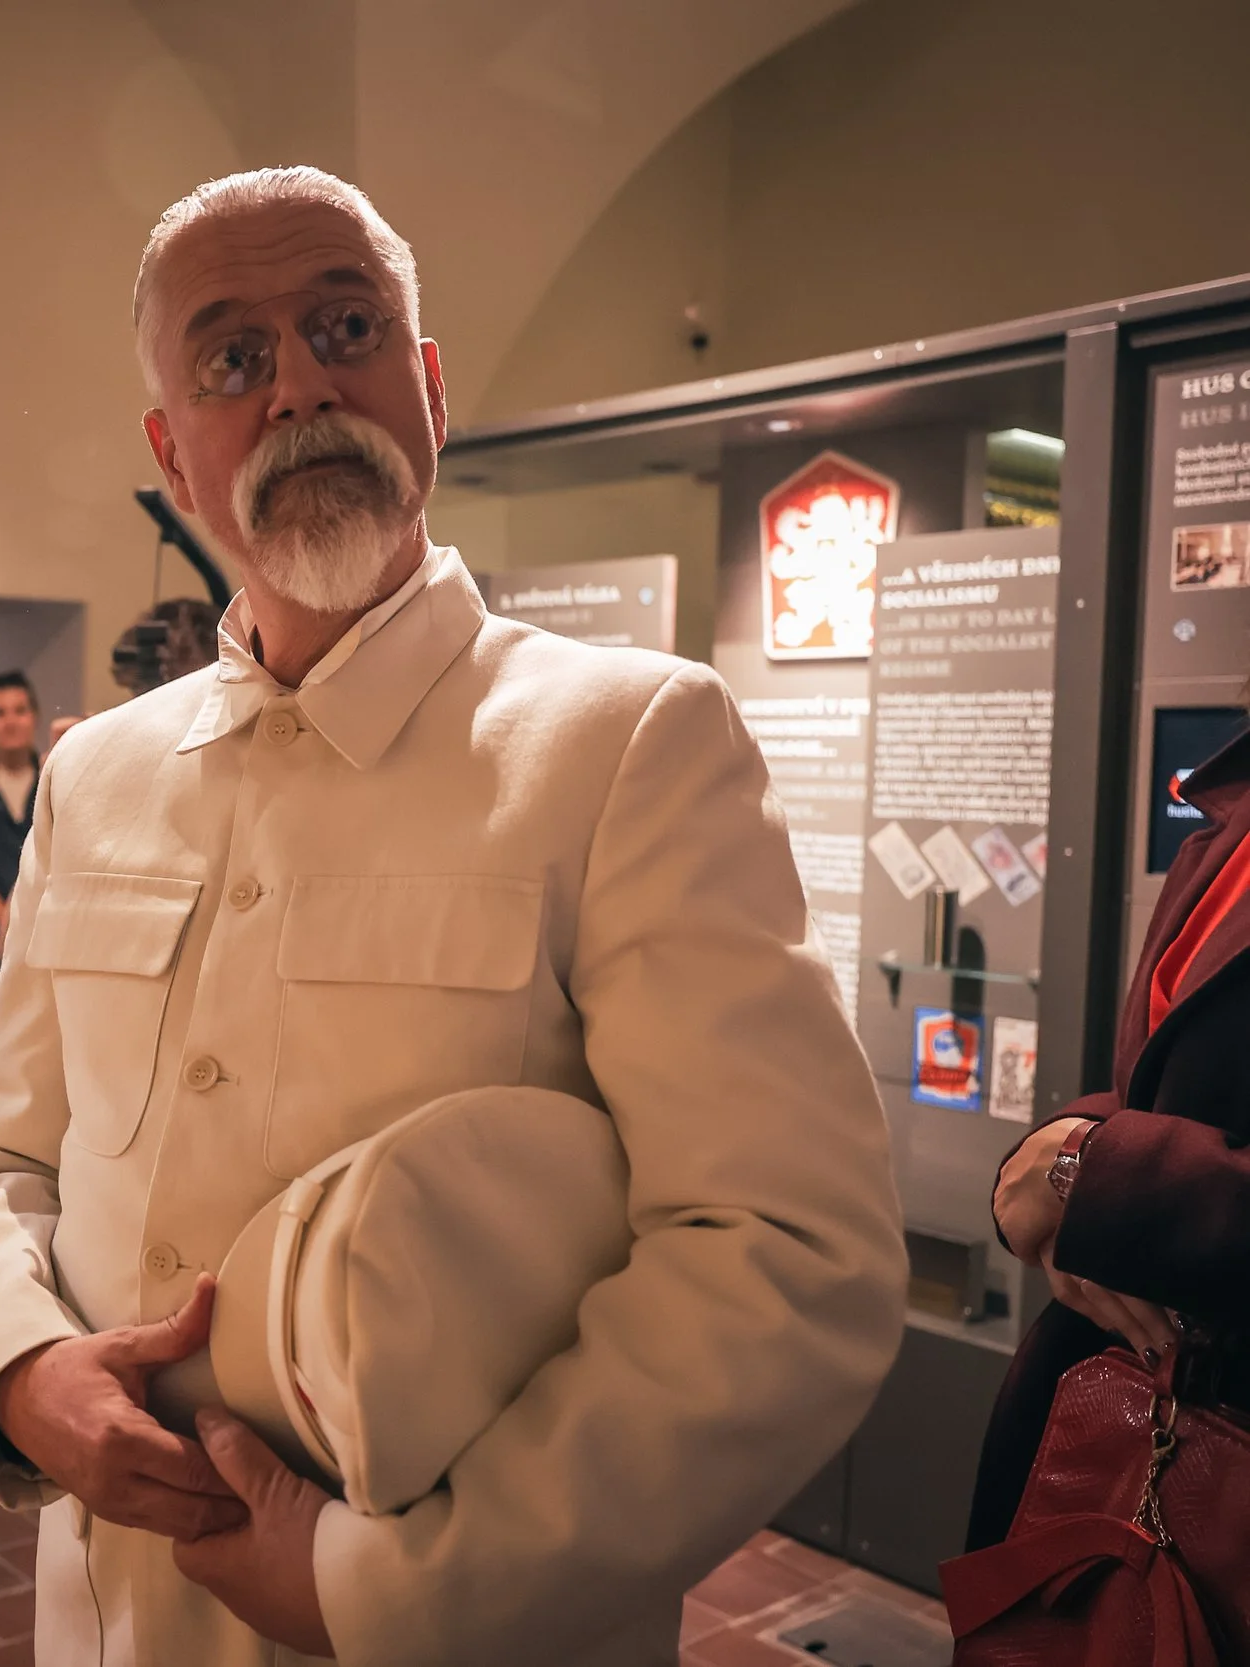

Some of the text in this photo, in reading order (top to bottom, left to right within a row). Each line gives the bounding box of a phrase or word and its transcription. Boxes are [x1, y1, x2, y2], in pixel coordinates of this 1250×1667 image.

[1182, 373, 1235, 399] HUS
[1180, 404, 1232, 429] HUS
[880, 584, 999, 609] SOCIALISMU
[967, 609, 994, 628] TO
[997, 607, 1037, 627] DAY
